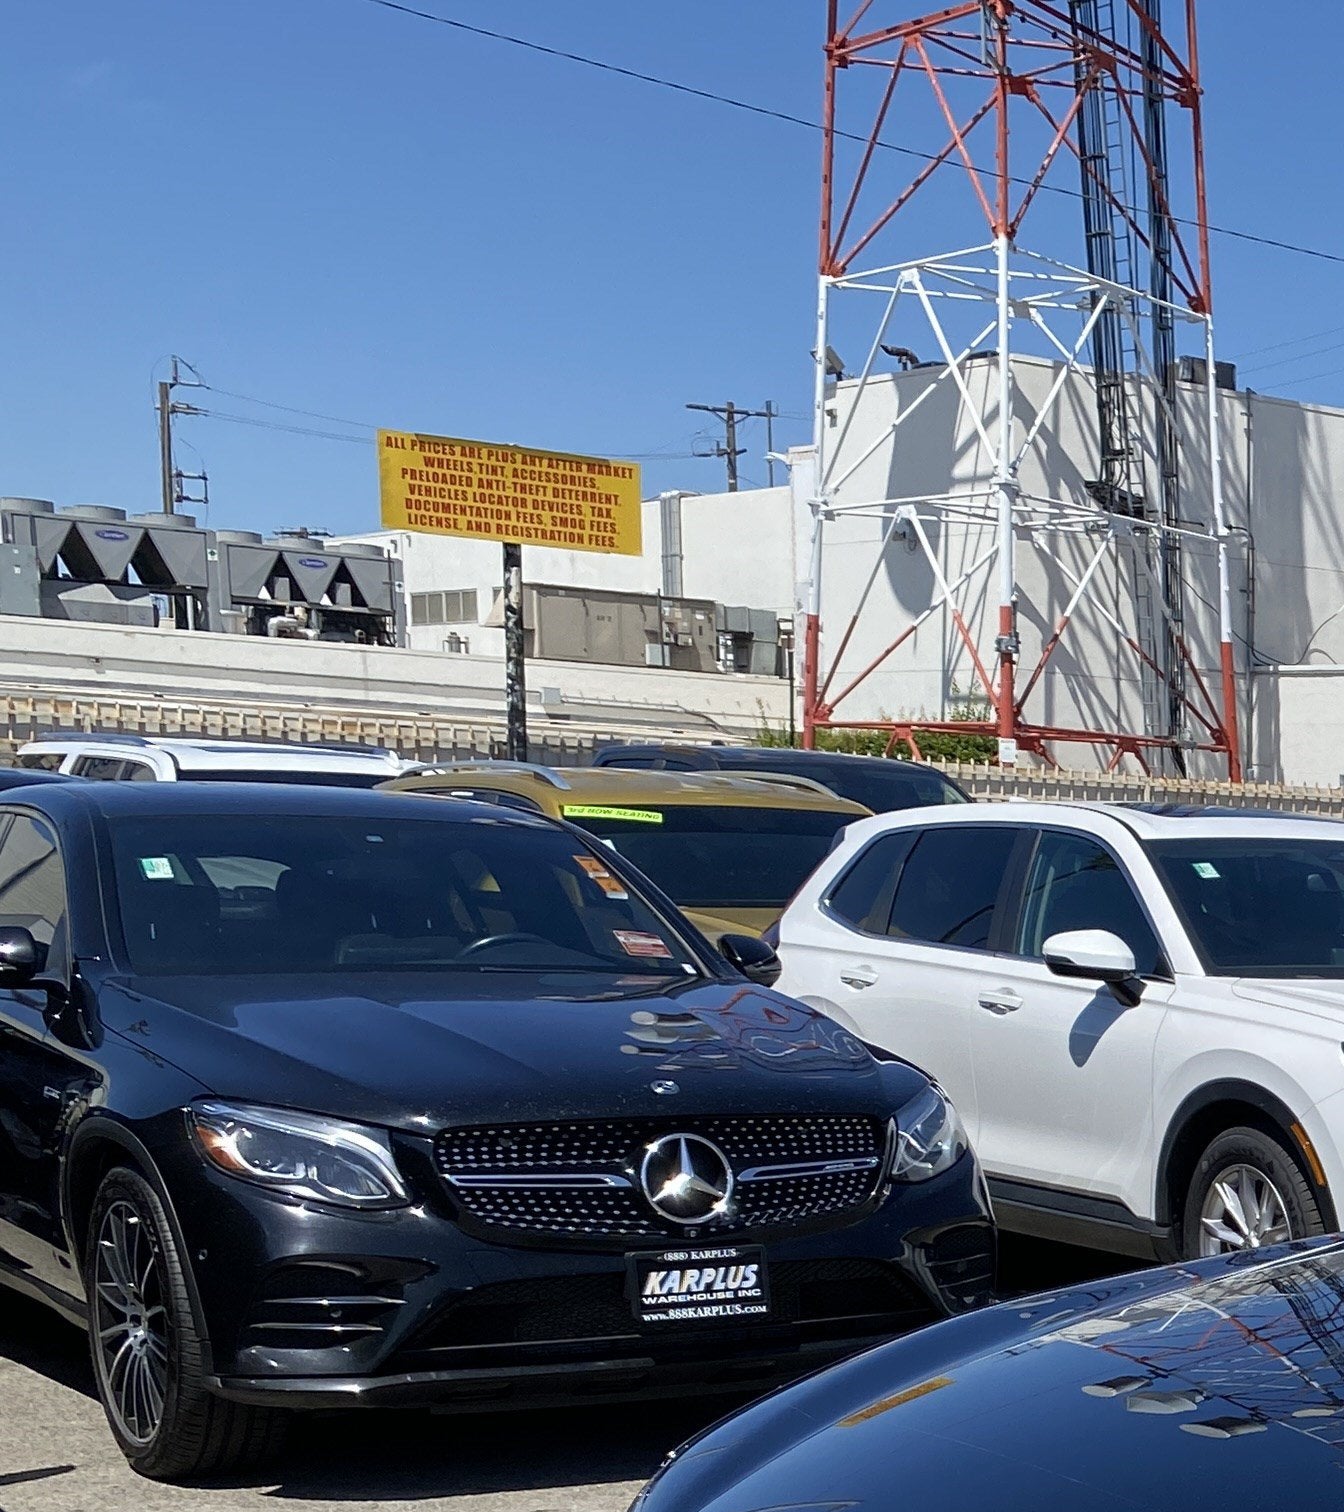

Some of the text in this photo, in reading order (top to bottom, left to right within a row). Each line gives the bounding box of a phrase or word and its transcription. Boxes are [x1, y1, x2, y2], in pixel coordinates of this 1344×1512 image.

[386, 436, 634, 479] ALL PRICES ARE PLUS ANY AFTER MARKET
[401, 467, 473, 488] PRELOADED
[477, 478, 548, 497] ANTI-THEFT
[408, 483, 468, 502] VEHICLES
[473, 491, 527, 509] LOCATOR
[405, 497, 512, 521] DOCUMENTATION
[551, 515, 586, 530] SMOG
[466, 520, 491, 534] AND
[496, 523, 584, 544] REGISTRATION
[616, 810, 660, 820] SEATING
[663, 1248, 738, 1262] (888) KARPLUS
[642, 1264, 760, 1296] KARPLUS
[642, 1288, 762, 1305] WAREHOUSE INC
